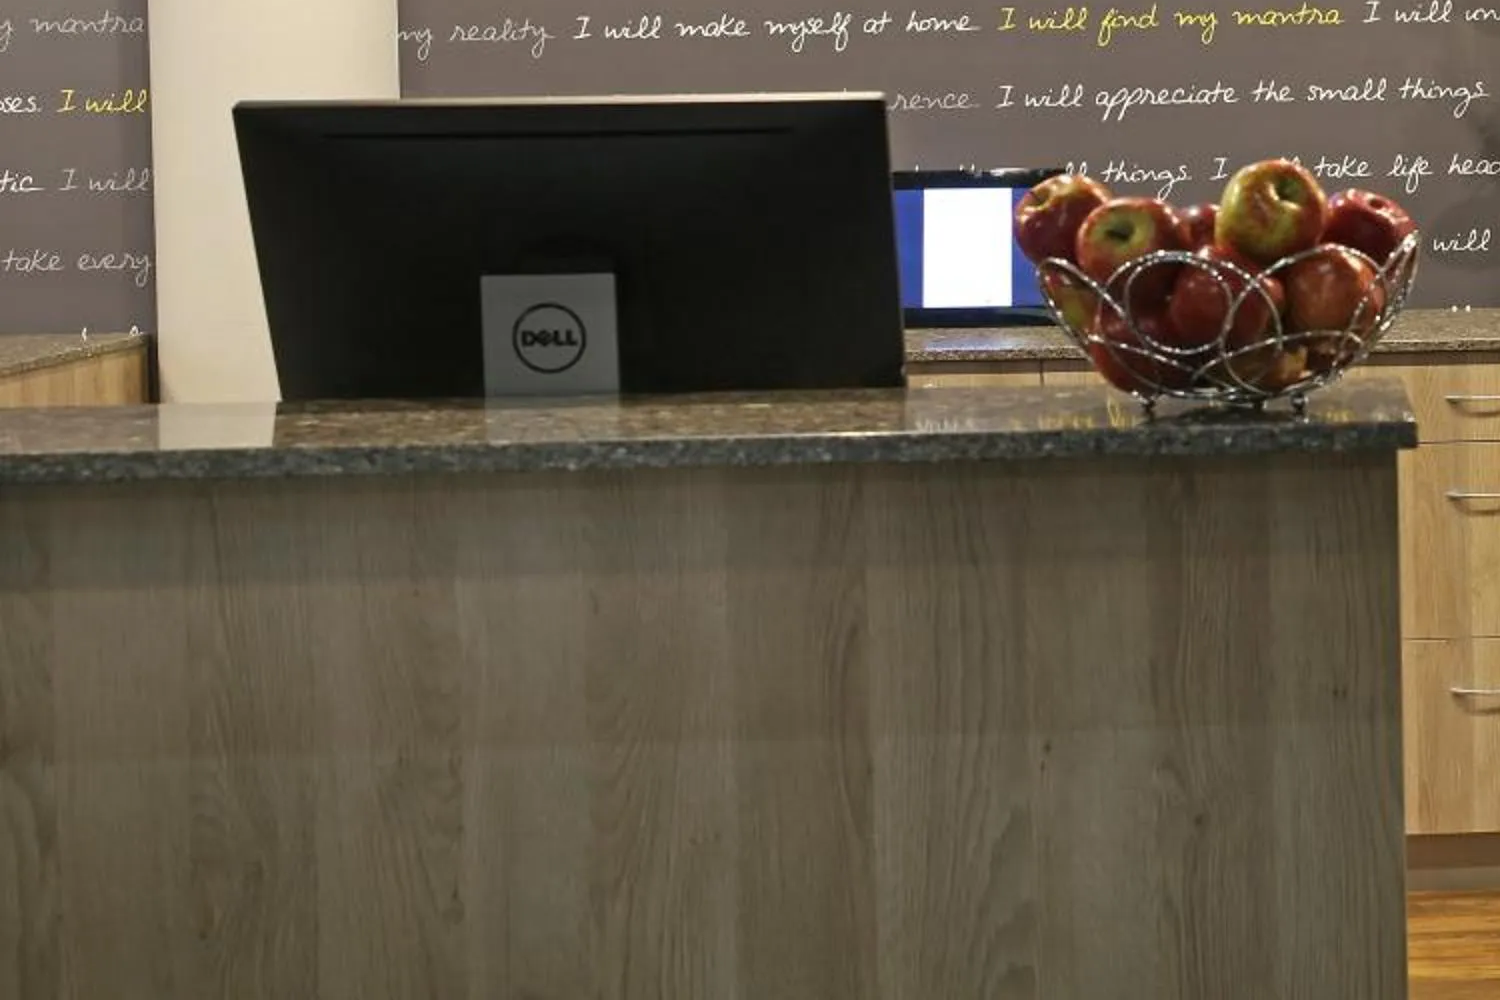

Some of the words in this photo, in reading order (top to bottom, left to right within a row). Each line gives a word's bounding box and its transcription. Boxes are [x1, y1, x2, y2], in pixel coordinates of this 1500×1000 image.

[762, 10, 854, 54] myself
[861, 9, 894, 36] at
[1096, 1, 1161, 48] find
[1172, 9, 1220, 46] my
[54, 87, 78, 114] I
[1023, 82, 1085, 110] will
[1094, 79, 1242, 124] appreciate
[1249, 78, 1297, 104] the
[1305, 75, 1389, 103] small
[1384, 152, 1436, 196] life
[1432, 226, 1493, 253] will
[0, 246, 66, 274] take
[76, 251, 148, 288] every
[521, 329, 579, 347] DELL
